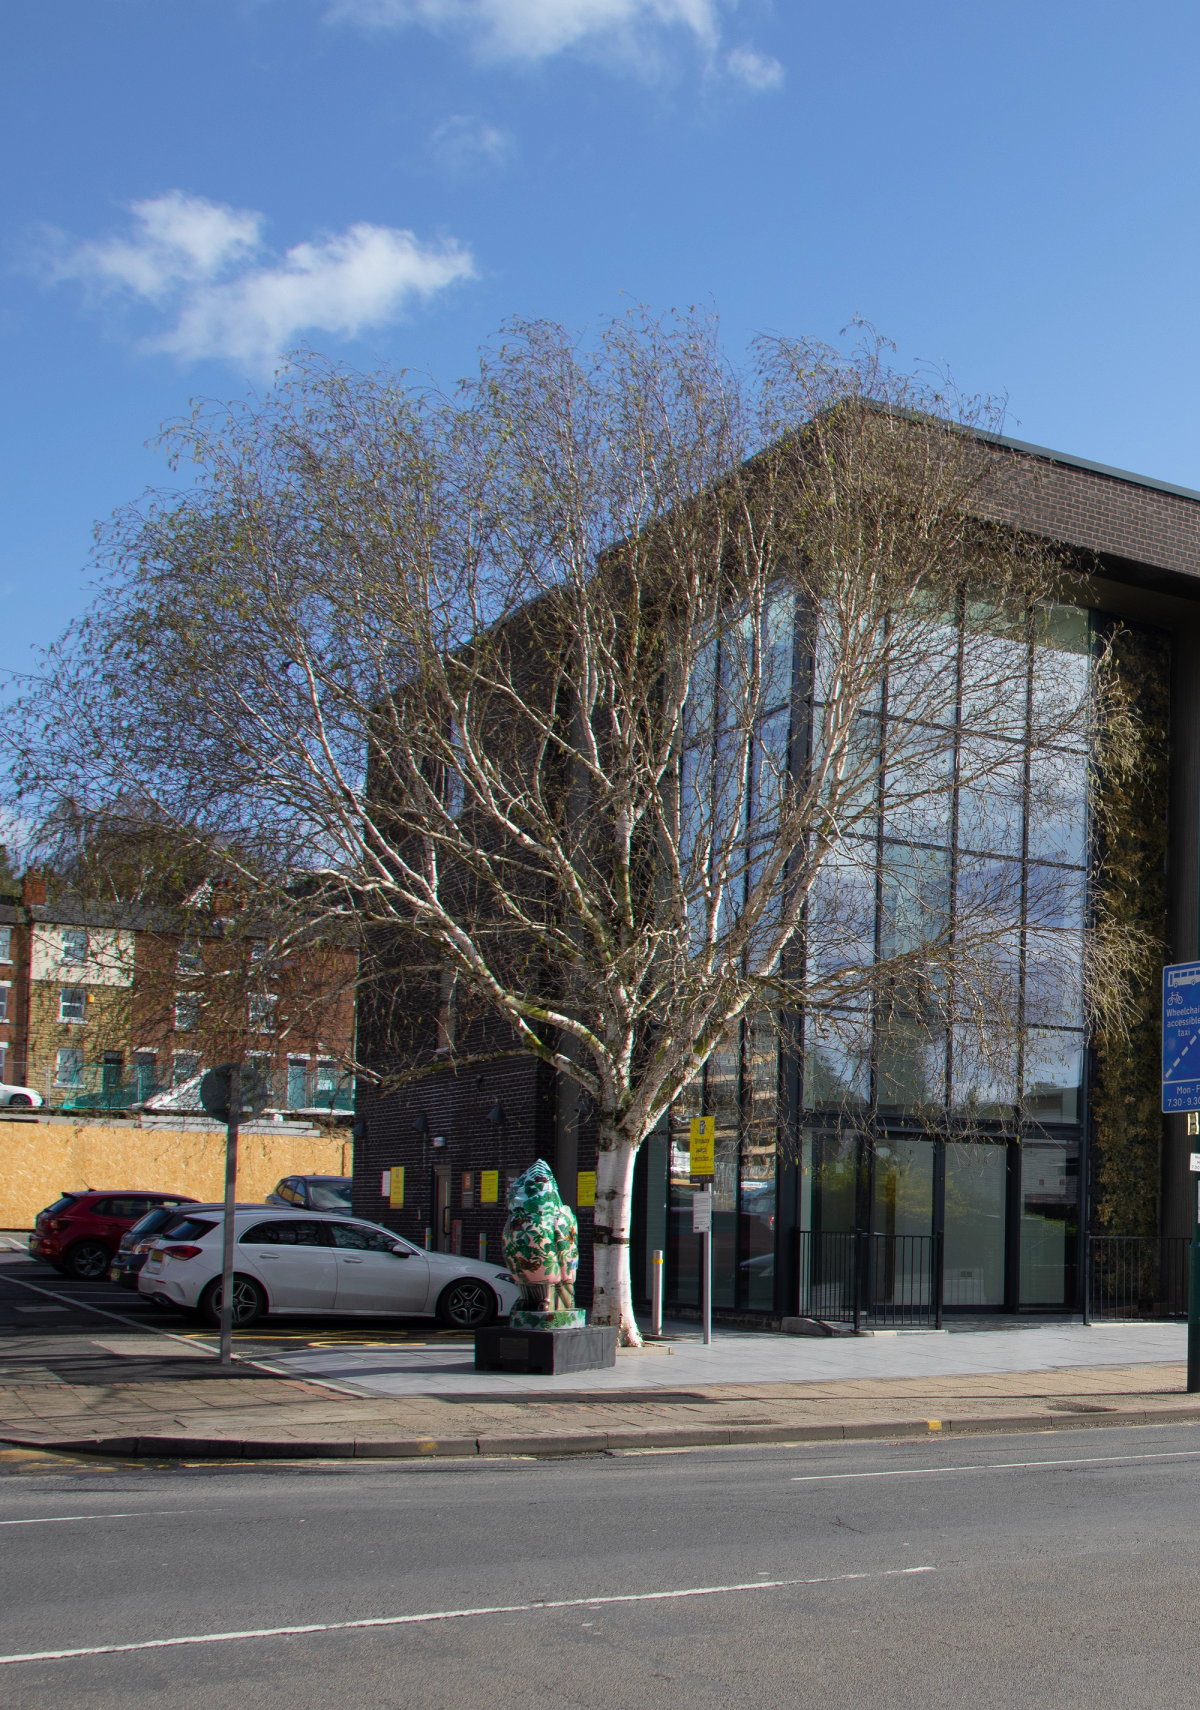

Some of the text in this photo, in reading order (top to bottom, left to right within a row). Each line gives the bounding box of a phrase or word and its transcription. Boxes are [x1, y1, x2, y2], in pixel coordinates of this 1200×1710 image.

[1177, 1028, 1191, 1037] taxi
[1176, 1086, 1191, 1095] Mon
[1167, 1097, 1182, 1107] 7.30
